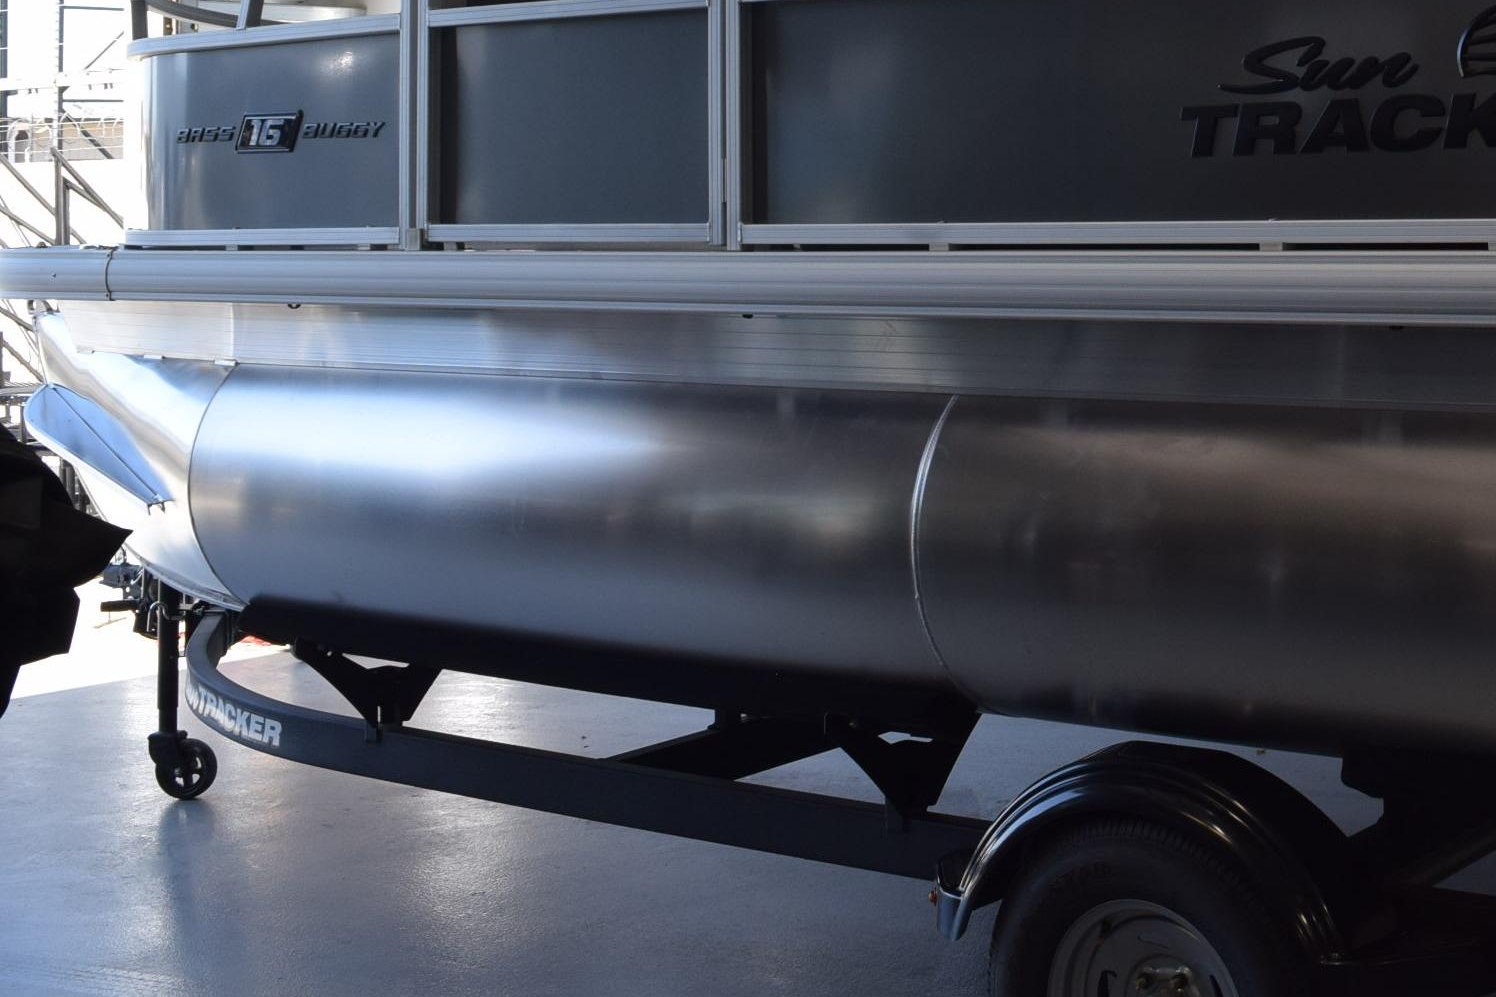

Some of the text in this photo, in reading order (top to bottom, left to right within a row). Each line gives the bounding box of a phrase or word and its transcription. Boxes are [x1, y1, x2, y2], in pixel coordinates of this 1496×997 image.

[1216, 35, 1420, 95] Sun
[176, 118, 386, 147] BASS 16 BUGGY
[197, 682, 282, 747] TRACKER
